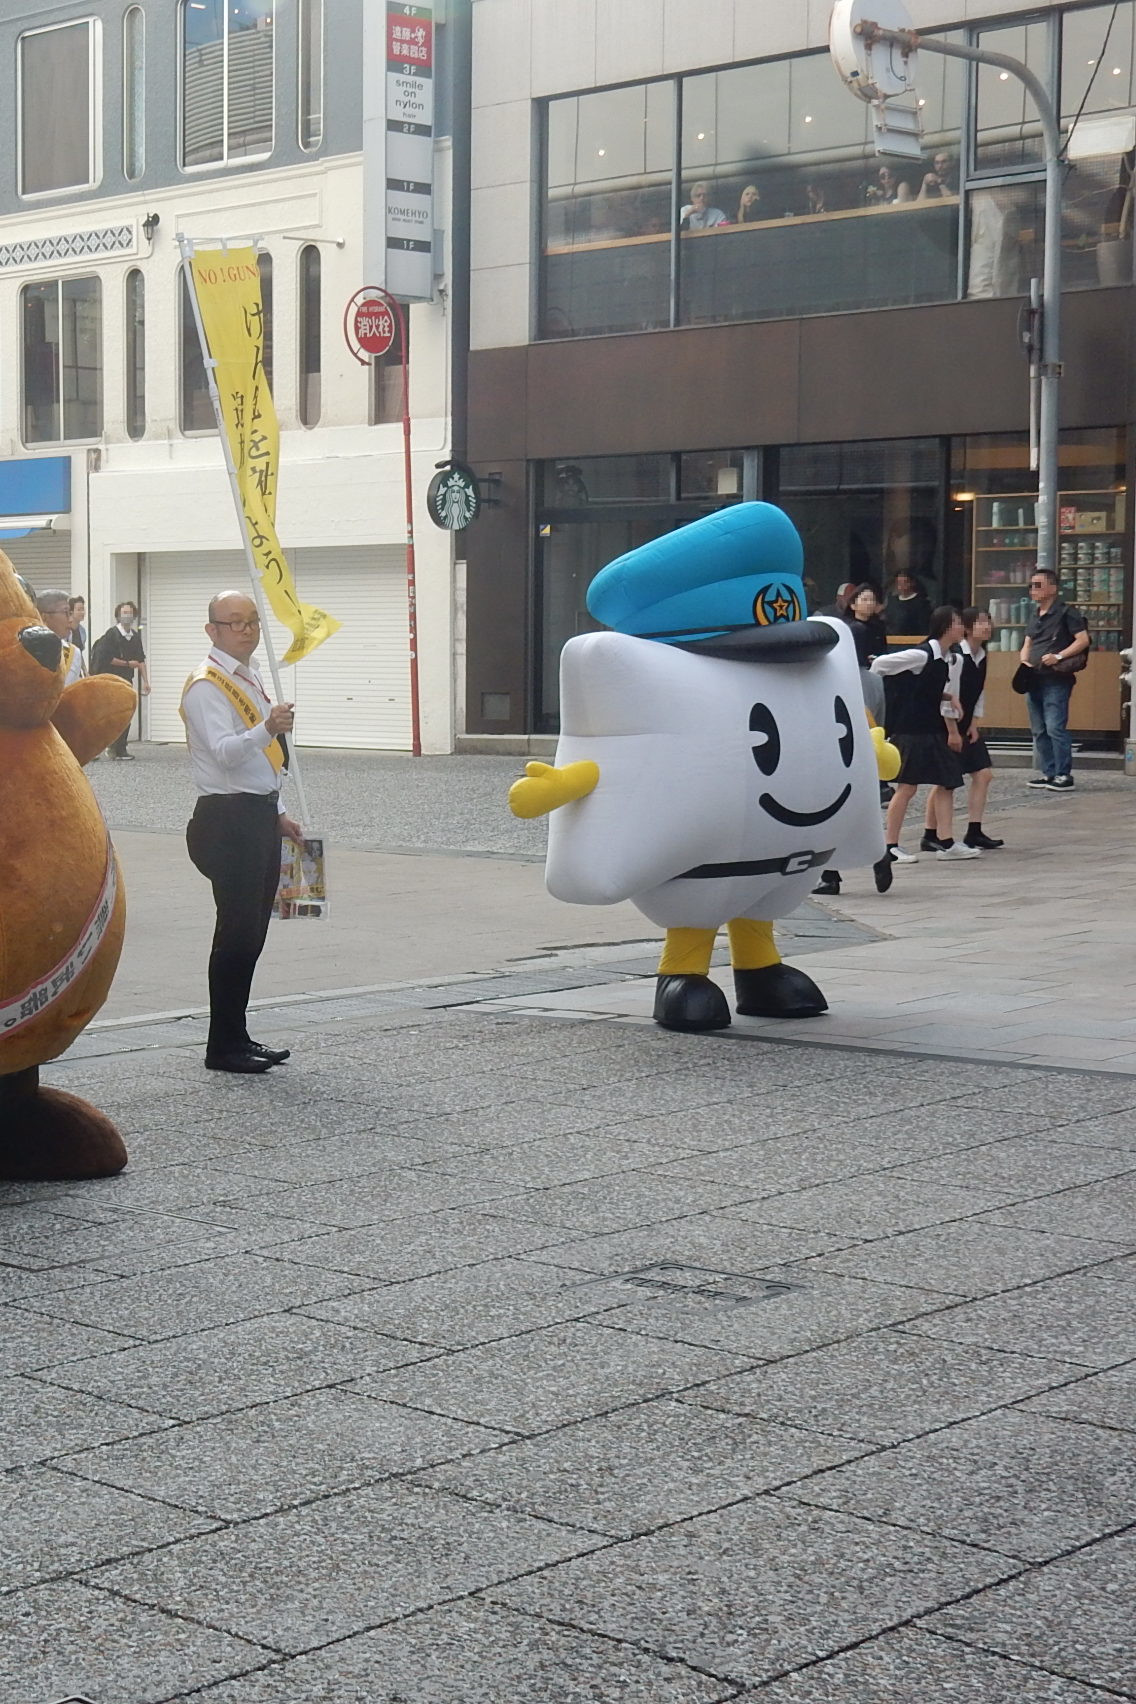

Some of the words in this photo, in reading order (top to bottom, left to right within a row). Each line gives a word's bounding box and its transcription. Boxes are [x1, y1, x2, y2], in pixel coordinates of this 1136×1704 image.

[403, 5, 417, 17] 4F
[403, 64, 417, 75] 3F
[395, 79, 424, 91] smile
[403, 89, 417, 98] on
[395, 98, 424, 111] nylon
[402, 124, 416, 133] 2F
[387, 205, 429, 220] KOMEHYO
[357, 315, 391, 338] 消火栓
